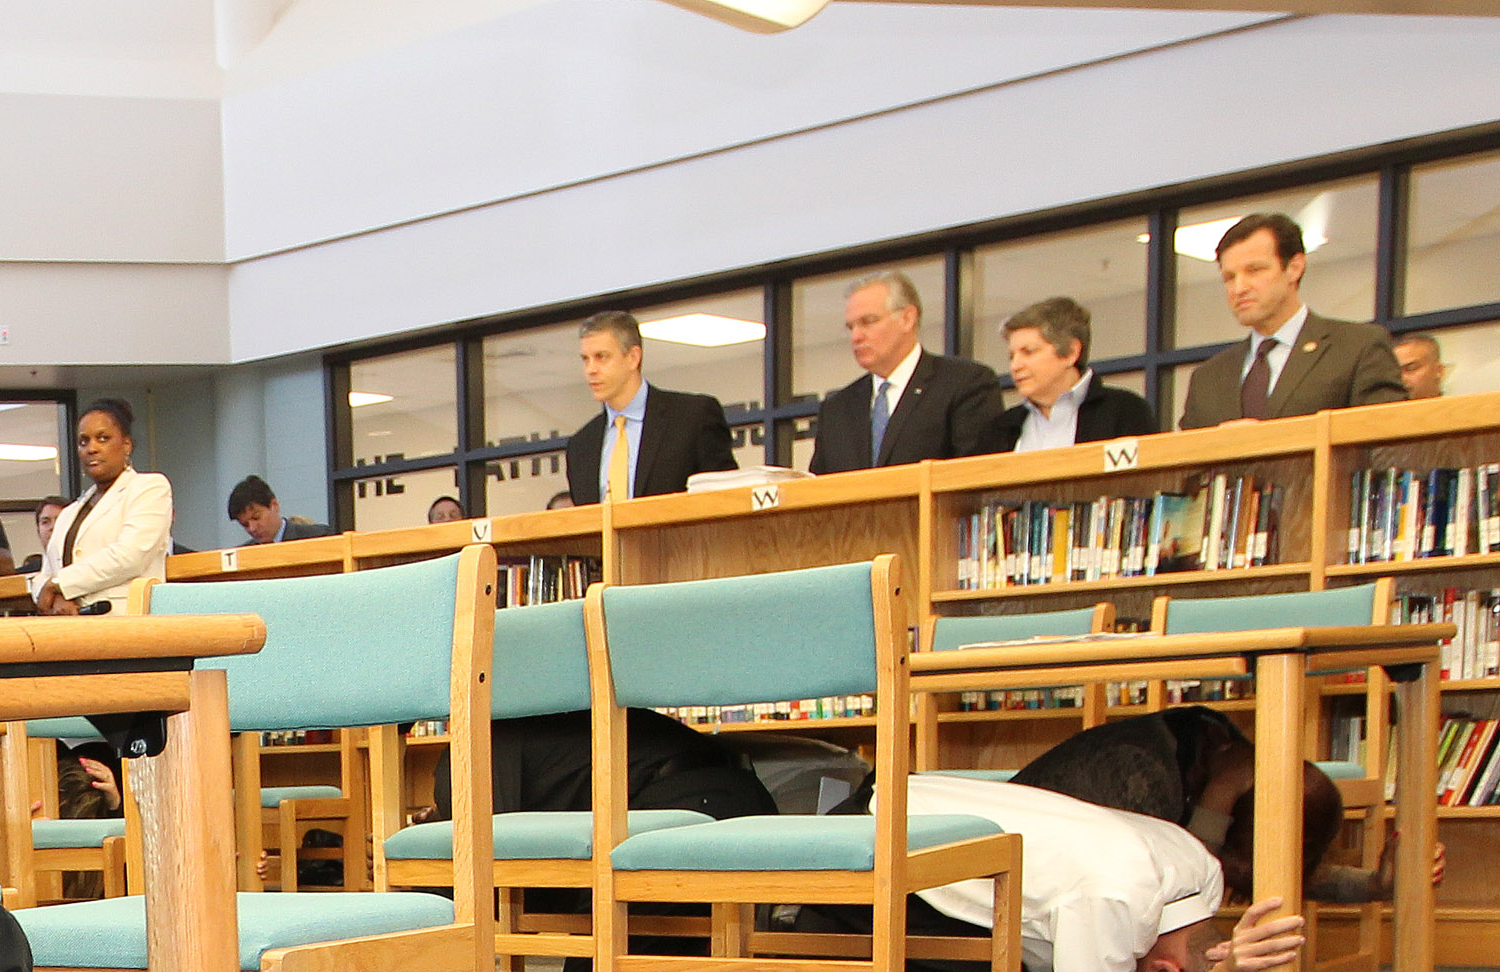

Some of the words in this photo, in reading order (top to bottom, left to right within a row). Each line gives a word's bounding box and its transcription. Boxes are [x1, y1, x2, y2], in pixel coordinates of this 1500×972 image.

[1107, 446, 1138, 468] W
[753, 489, 779, 508] W
[223, 551, 236, 566] T
